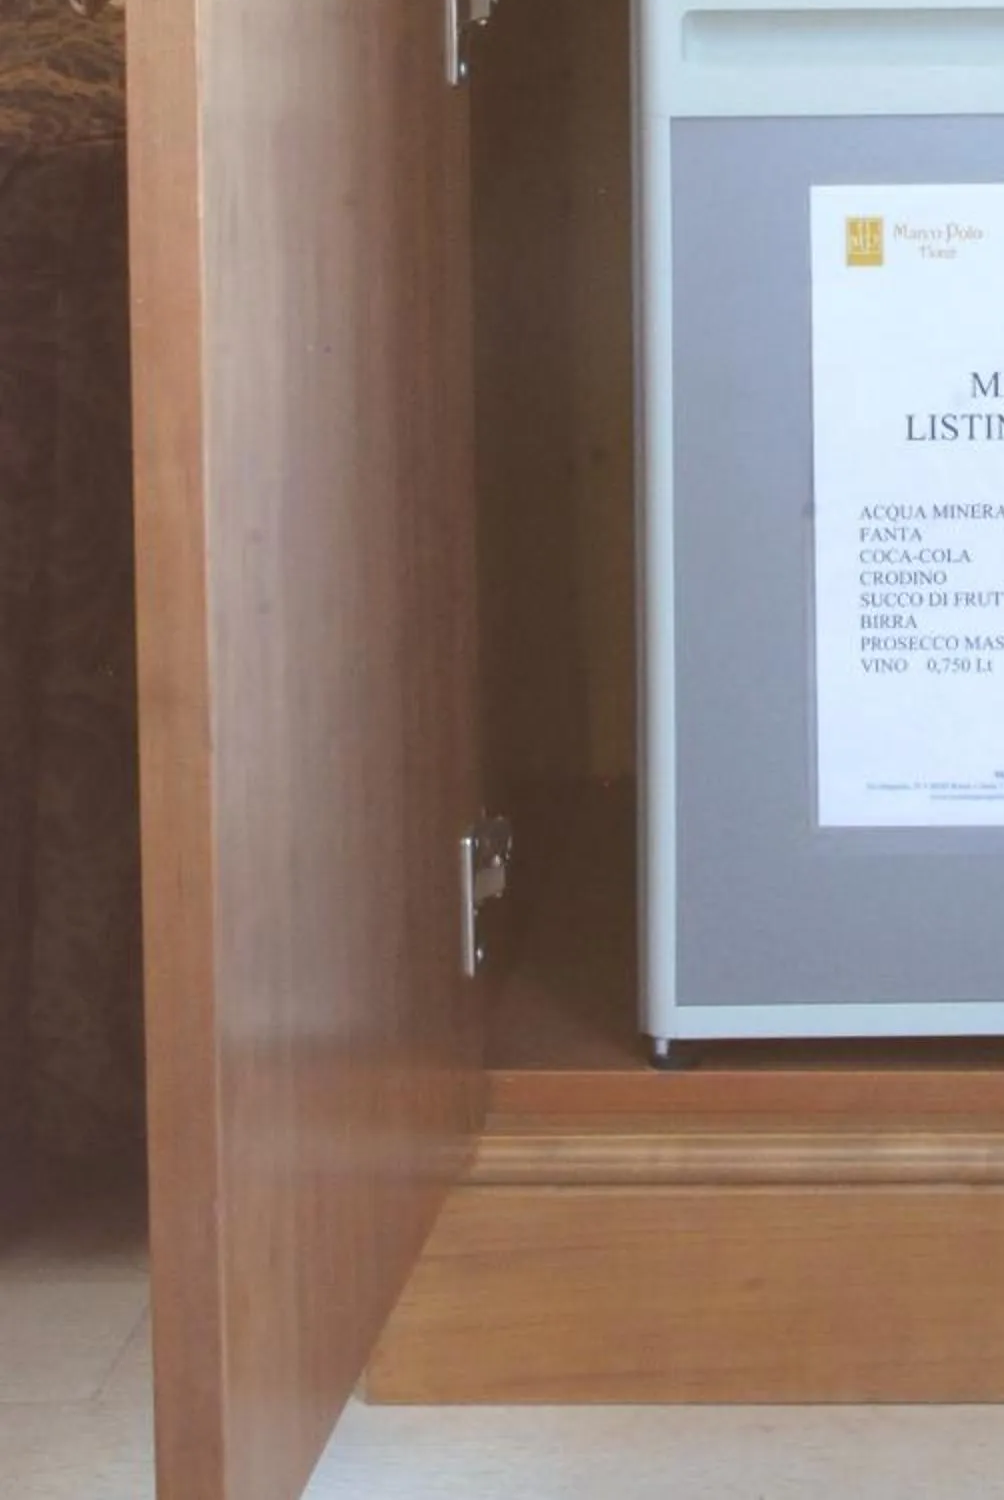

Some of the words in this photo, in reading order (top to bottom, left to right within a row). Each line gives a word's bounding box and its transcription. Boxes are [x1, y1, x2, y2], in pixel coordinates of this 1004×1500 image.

[945, 221, 983, 243] Polo
[860, 503, 928, 523] ACQUA
[859, 525, 923, 543] FANTA
[858, 546, 972, 565] COCA-COLA
[859, 569, 948, 587] CRODINO
[859, 591, 925, 609] SUCCO
[928, 591, 949, 608] DI
[859, 613, 918, 630] BIRRA
[860, 635, 960, 652] PROSECCO
[860, 657, 909, 674] VINO
[926, 657, 972, 675] 0,750
